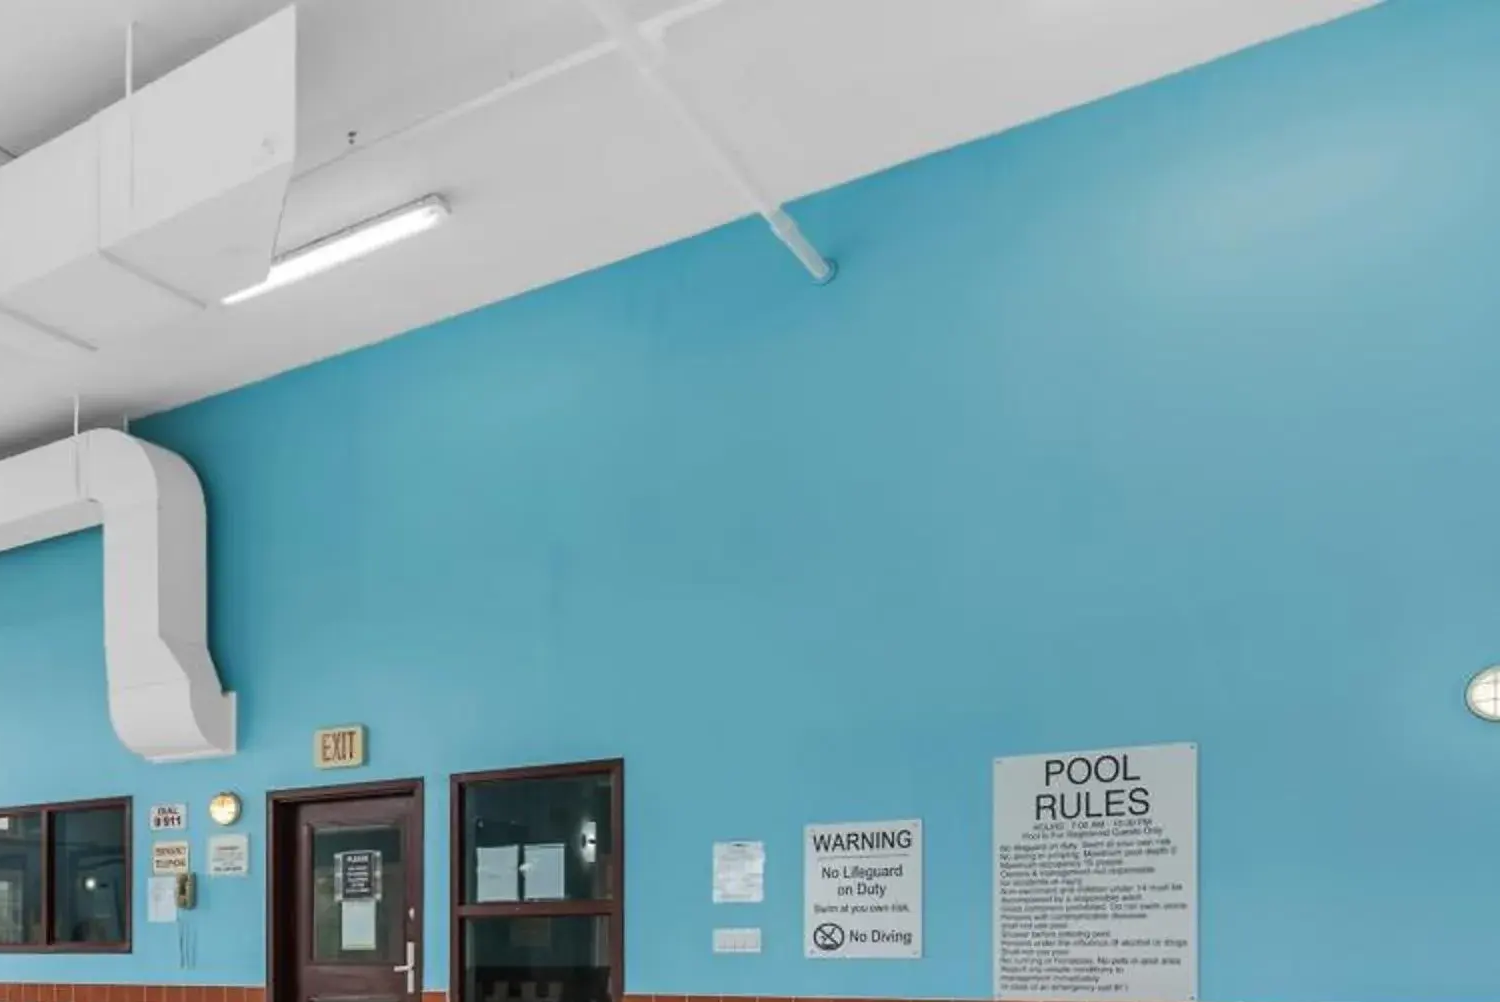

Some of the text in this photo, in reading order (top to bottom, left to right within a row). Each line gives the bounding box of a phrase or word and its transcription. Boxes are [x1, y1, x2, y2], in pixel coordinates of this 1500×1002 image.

[321, 731, 357, 761] EXIT
[1045, 754, 1141, 787] POOL
[1035, 787, 1150, 821] RULES
[812, 829, 913, 853] WARNING
[821, 864, 904, 881] No Lifeguard
[837, 882, 887, 899] on Duty
[849, 929, 913, 946] No Diving
